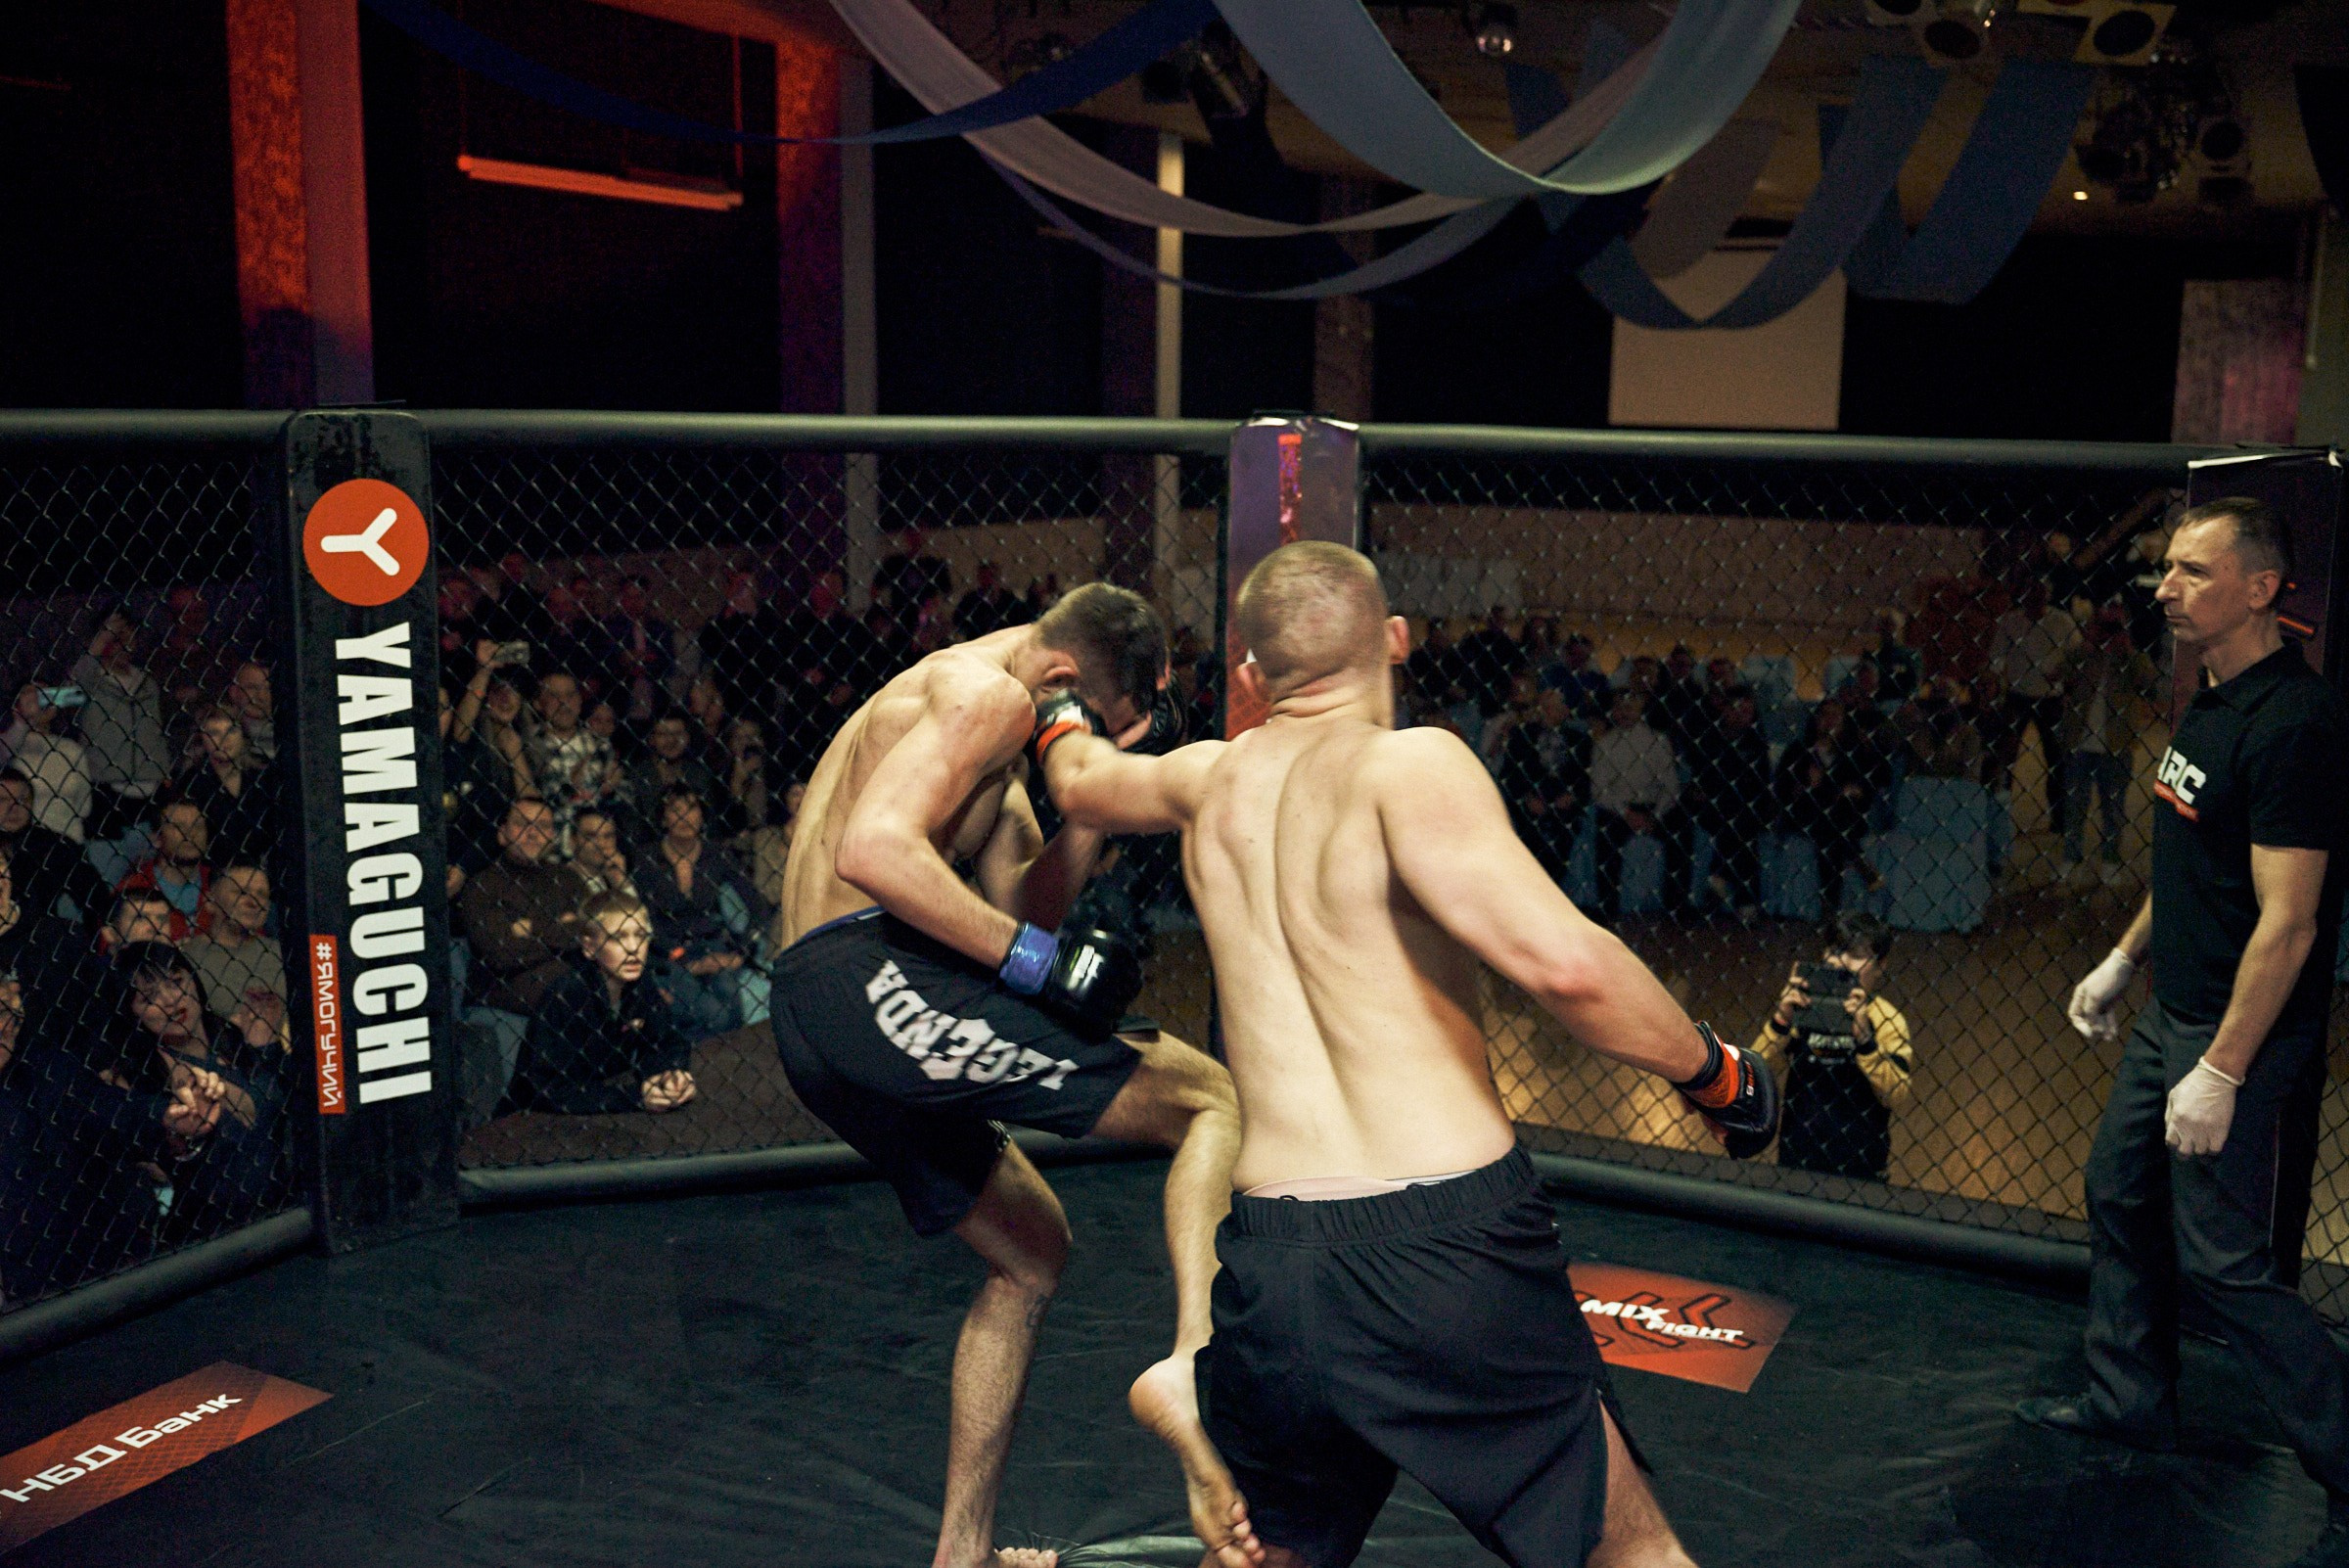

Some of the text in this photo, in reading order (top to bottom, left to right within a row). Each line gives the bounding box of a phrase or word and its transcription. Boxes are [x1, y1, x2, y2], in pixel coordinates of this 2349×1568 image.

[334, 621, 433, 1105] YAMAGUCHI
[314, 941, 343, 1108] #ЯМОГУЧИЙ
[865, 957, 1081, 1091] LEGENDA
[1580, 1299, 1670, 1323] MIX
[1645, 1321, 1745, 1343] FIGHT
[0, 1443, 128, 1502] НБД
